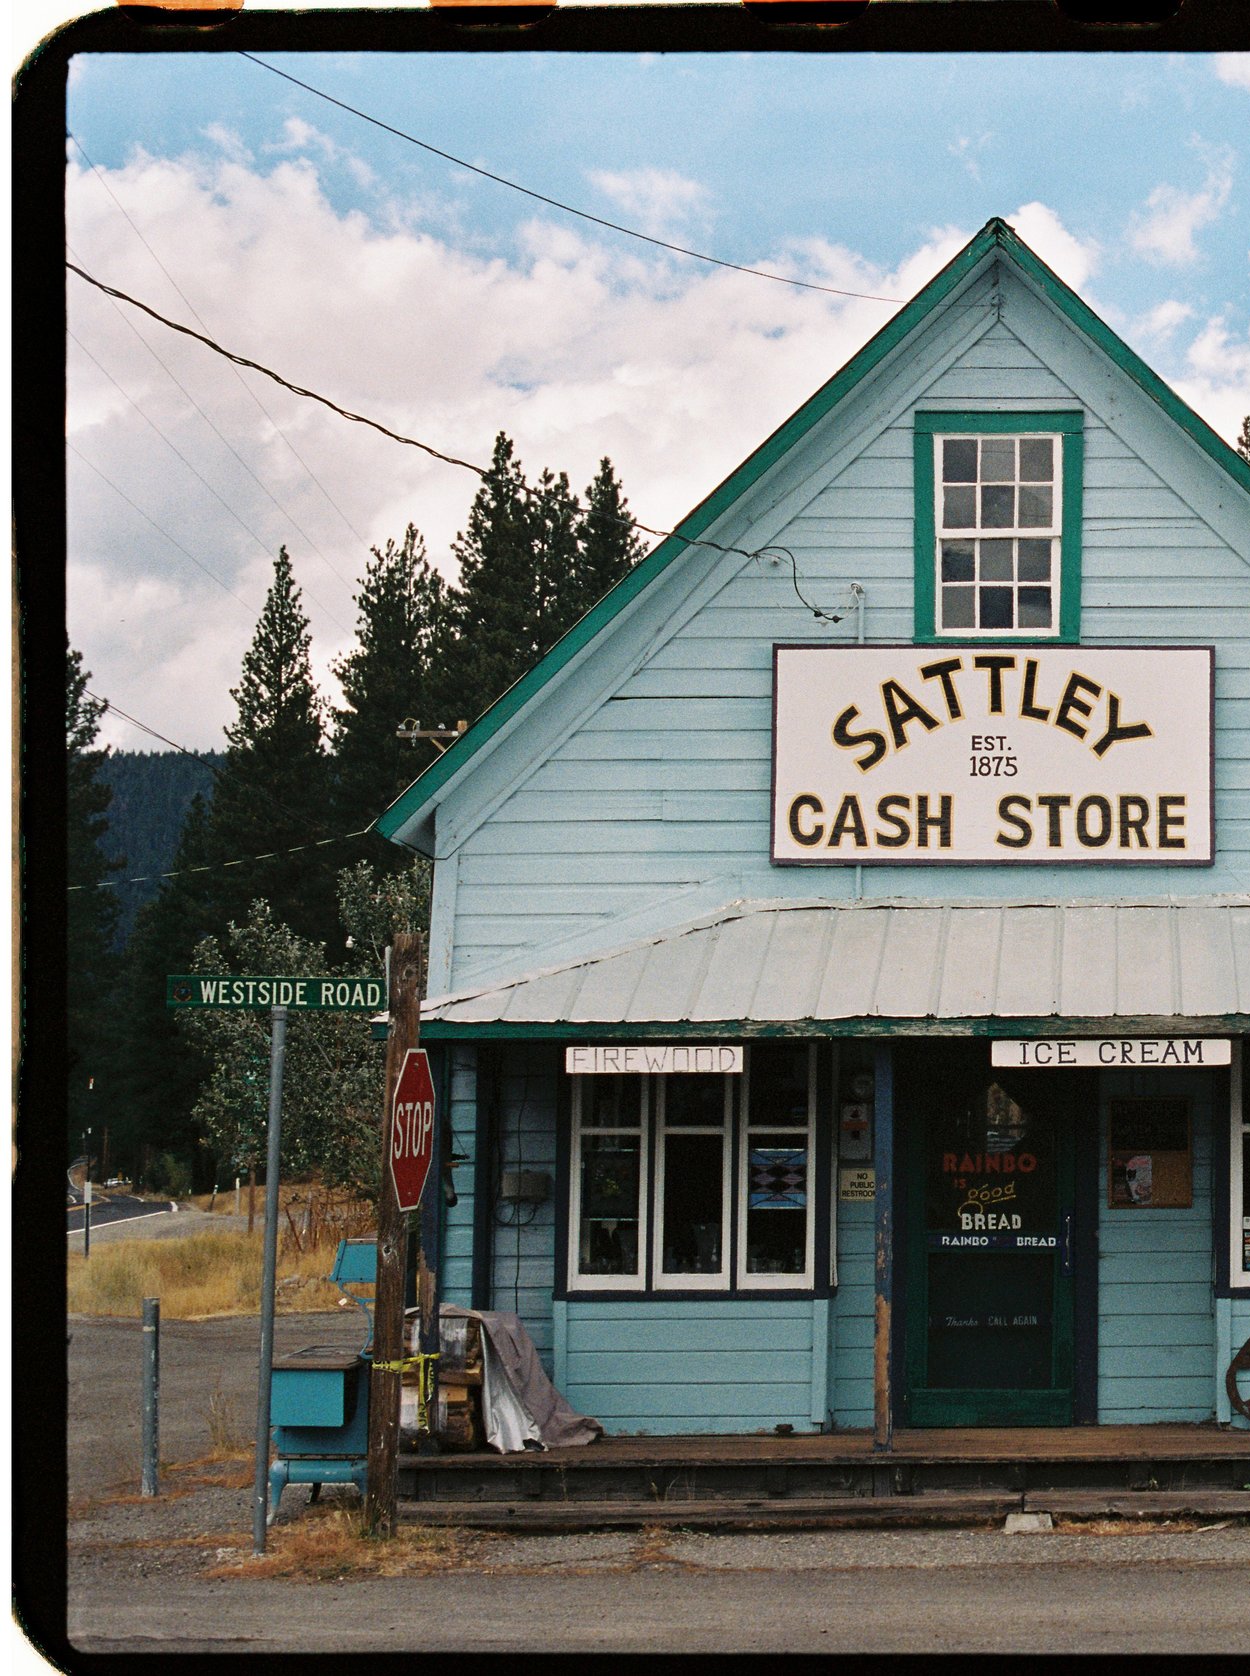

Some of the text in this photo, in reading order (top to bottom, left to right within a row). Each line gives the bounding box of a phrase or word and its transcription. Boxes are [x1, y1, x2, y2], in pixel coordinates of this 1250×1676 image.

[831, 653, 1155, 775] SATTLEY
[971, 735, 1012, 751] EST.
[969, 756, 1018, 777] 1875
[787, 792, 1188, 850] CASH STORE
[200, 980, 380, 1007] WESTSIDE ROAD
[572, 1047, 736, 1072] FIREWOOD
[1019, 1041, 1205, 1065] ICE CREAM
[394, 1101, 431, 1159] STOP
[943, 1152, 1038, 1174] RAINBO
[962, 1214, 1022, 1231] BREAD
[942, 1236, 989, 1247] RAINBO
[1017, 1237, 1057, 1247] BREAD
[988, 1315, 1009, 1327] CALL
[1012, 1315, 1038, 1327] AGAIN
